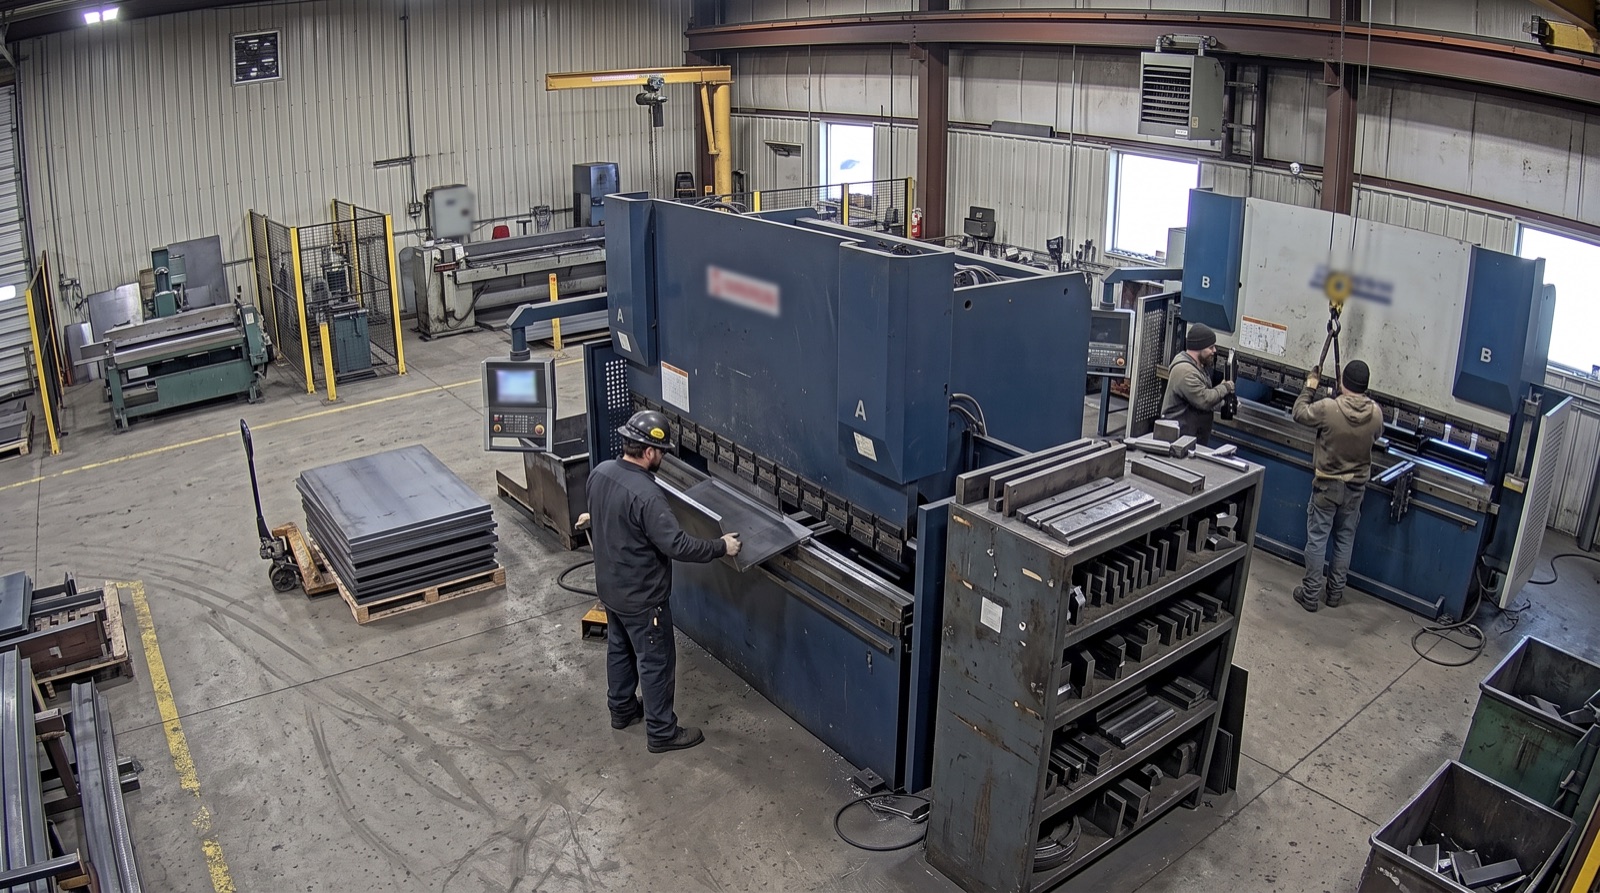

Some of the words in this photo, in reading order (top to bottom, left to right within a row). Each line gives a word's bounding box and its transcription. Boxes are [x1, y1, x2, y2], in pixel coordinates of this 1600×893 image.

[1201, 275, 1211, 288] B
[617, 308, 624, 323] A
[1480, 347, 1492, 363] B
[854, 399, 867, 422] A
